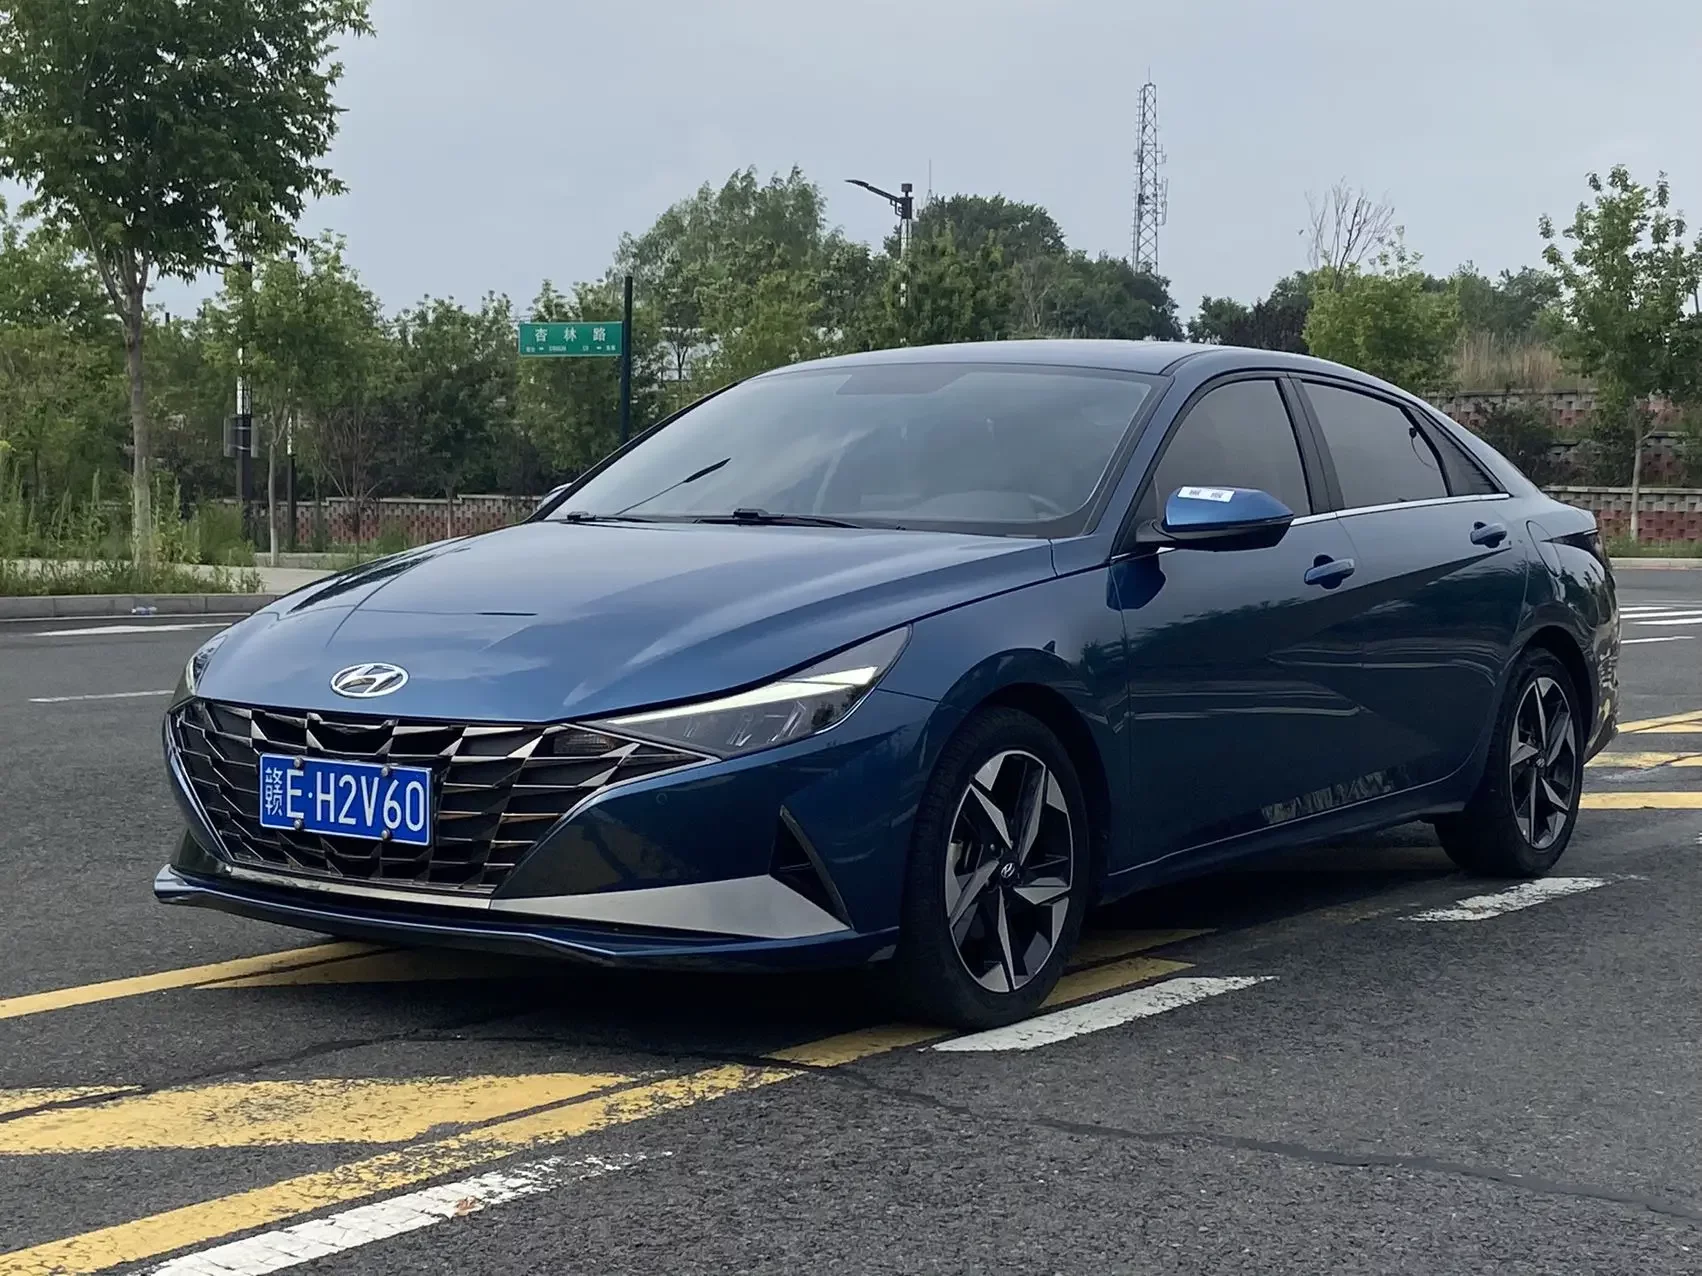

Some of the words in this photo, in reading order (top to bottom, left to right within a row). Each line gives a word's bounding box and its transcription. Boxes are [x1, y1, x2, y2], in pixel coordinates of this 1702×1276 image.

[535, 327, 606, 342] 杏林路
[265, 767, 425, 832] 赣E·H2V60
